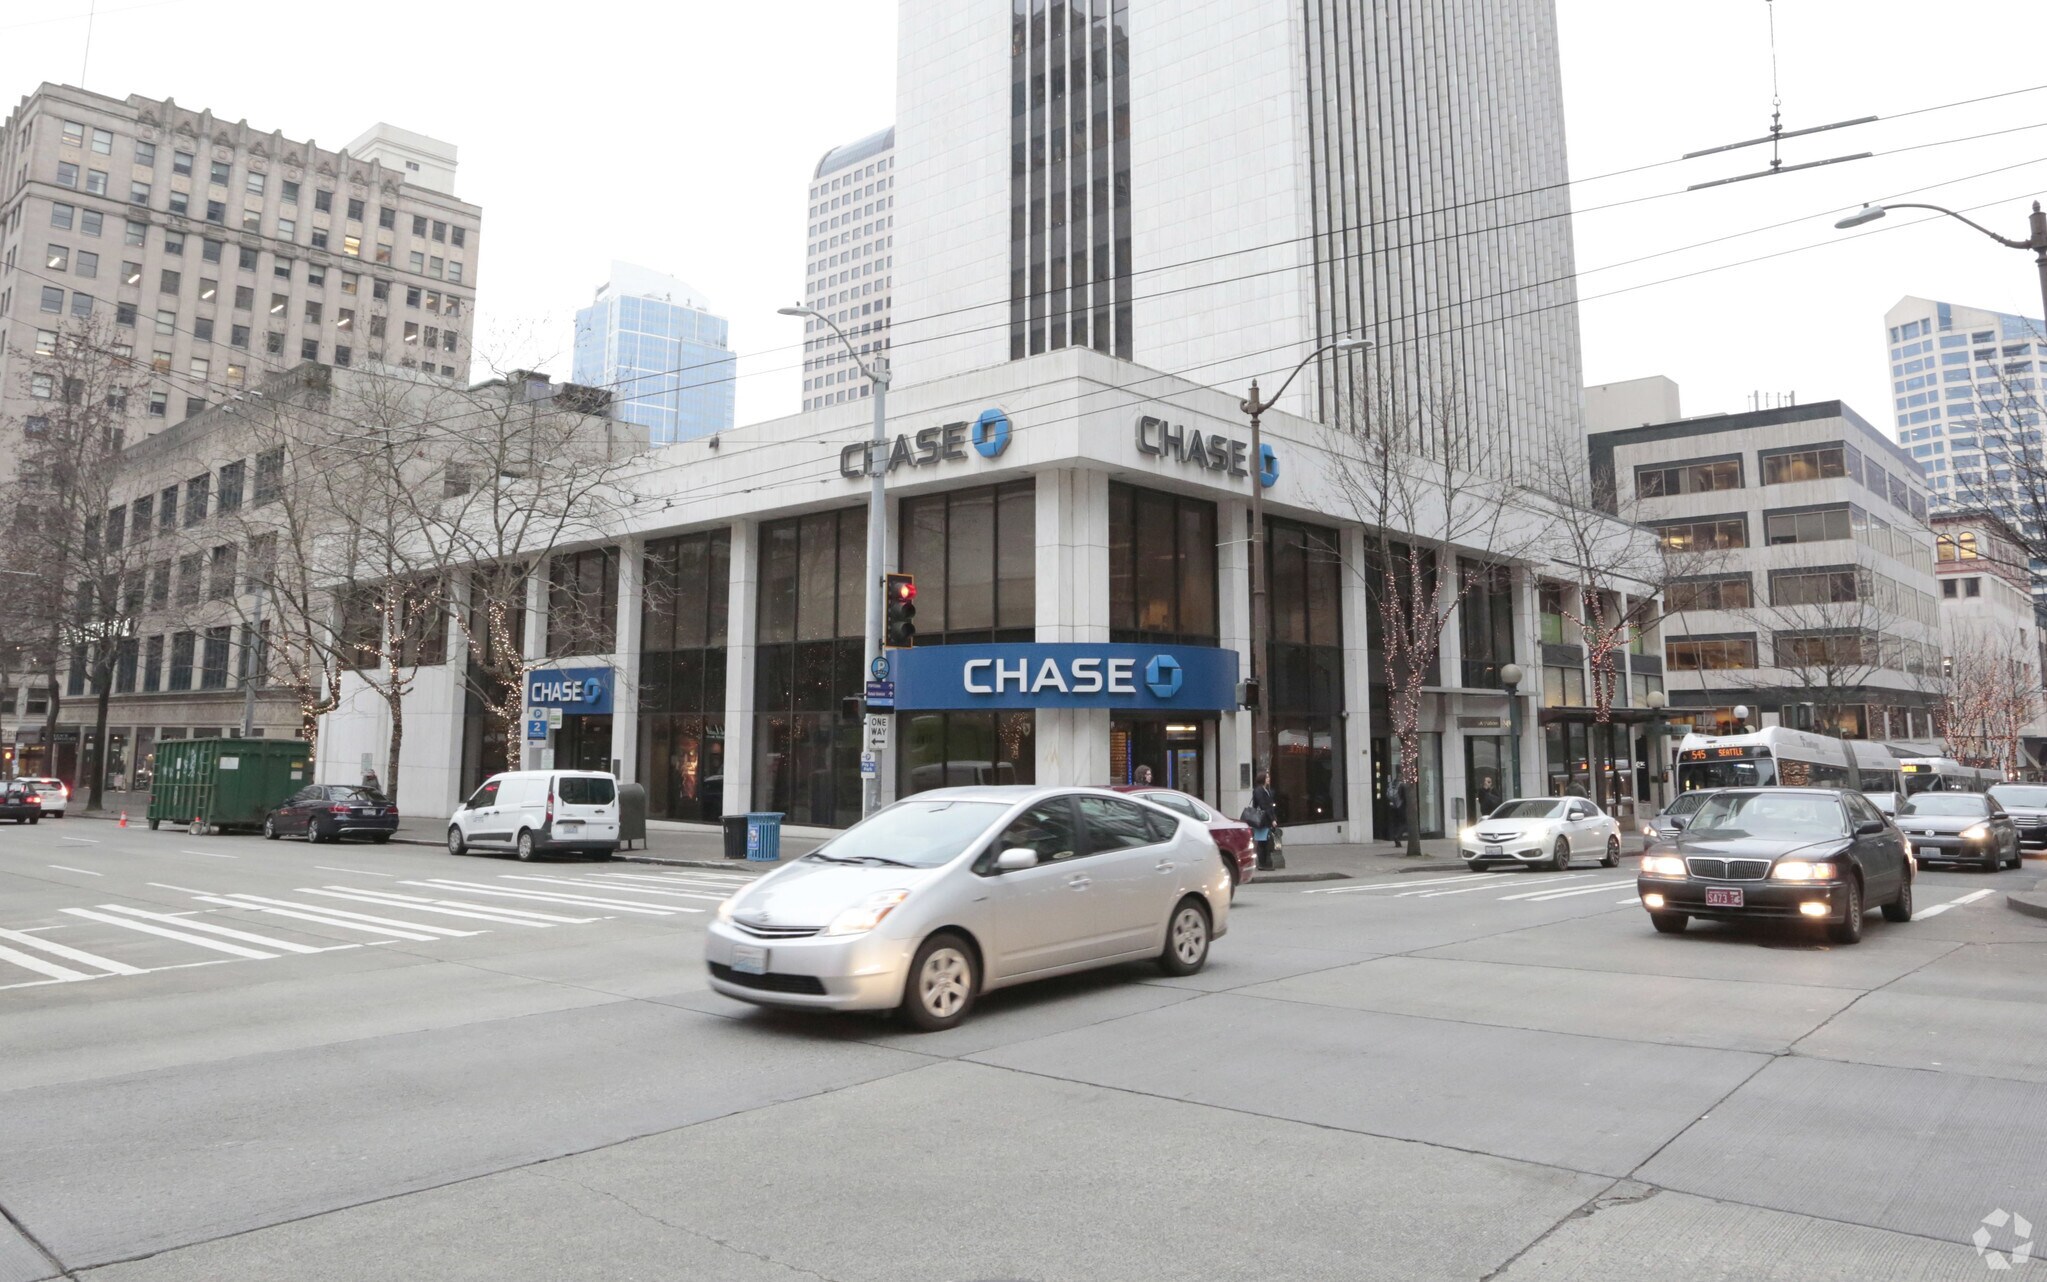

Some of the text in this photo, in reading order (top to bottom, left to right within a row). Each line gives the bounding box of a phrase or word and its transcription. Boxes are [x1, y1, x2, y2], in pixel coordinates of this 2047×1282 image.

[1135, 415, 1249, 477] CHASE
[963, 658, 1137, 693] CHASE
[532, 681, 582, 701] CHASE
[534, 722, 541, 731] 2
[871, 717, 887, 726] ONE
[871, 727, 887, 736] WAY
[1691, 748, 1743, 760] 545 SEATTLE
[1708, 893, 1728, 904] S473
